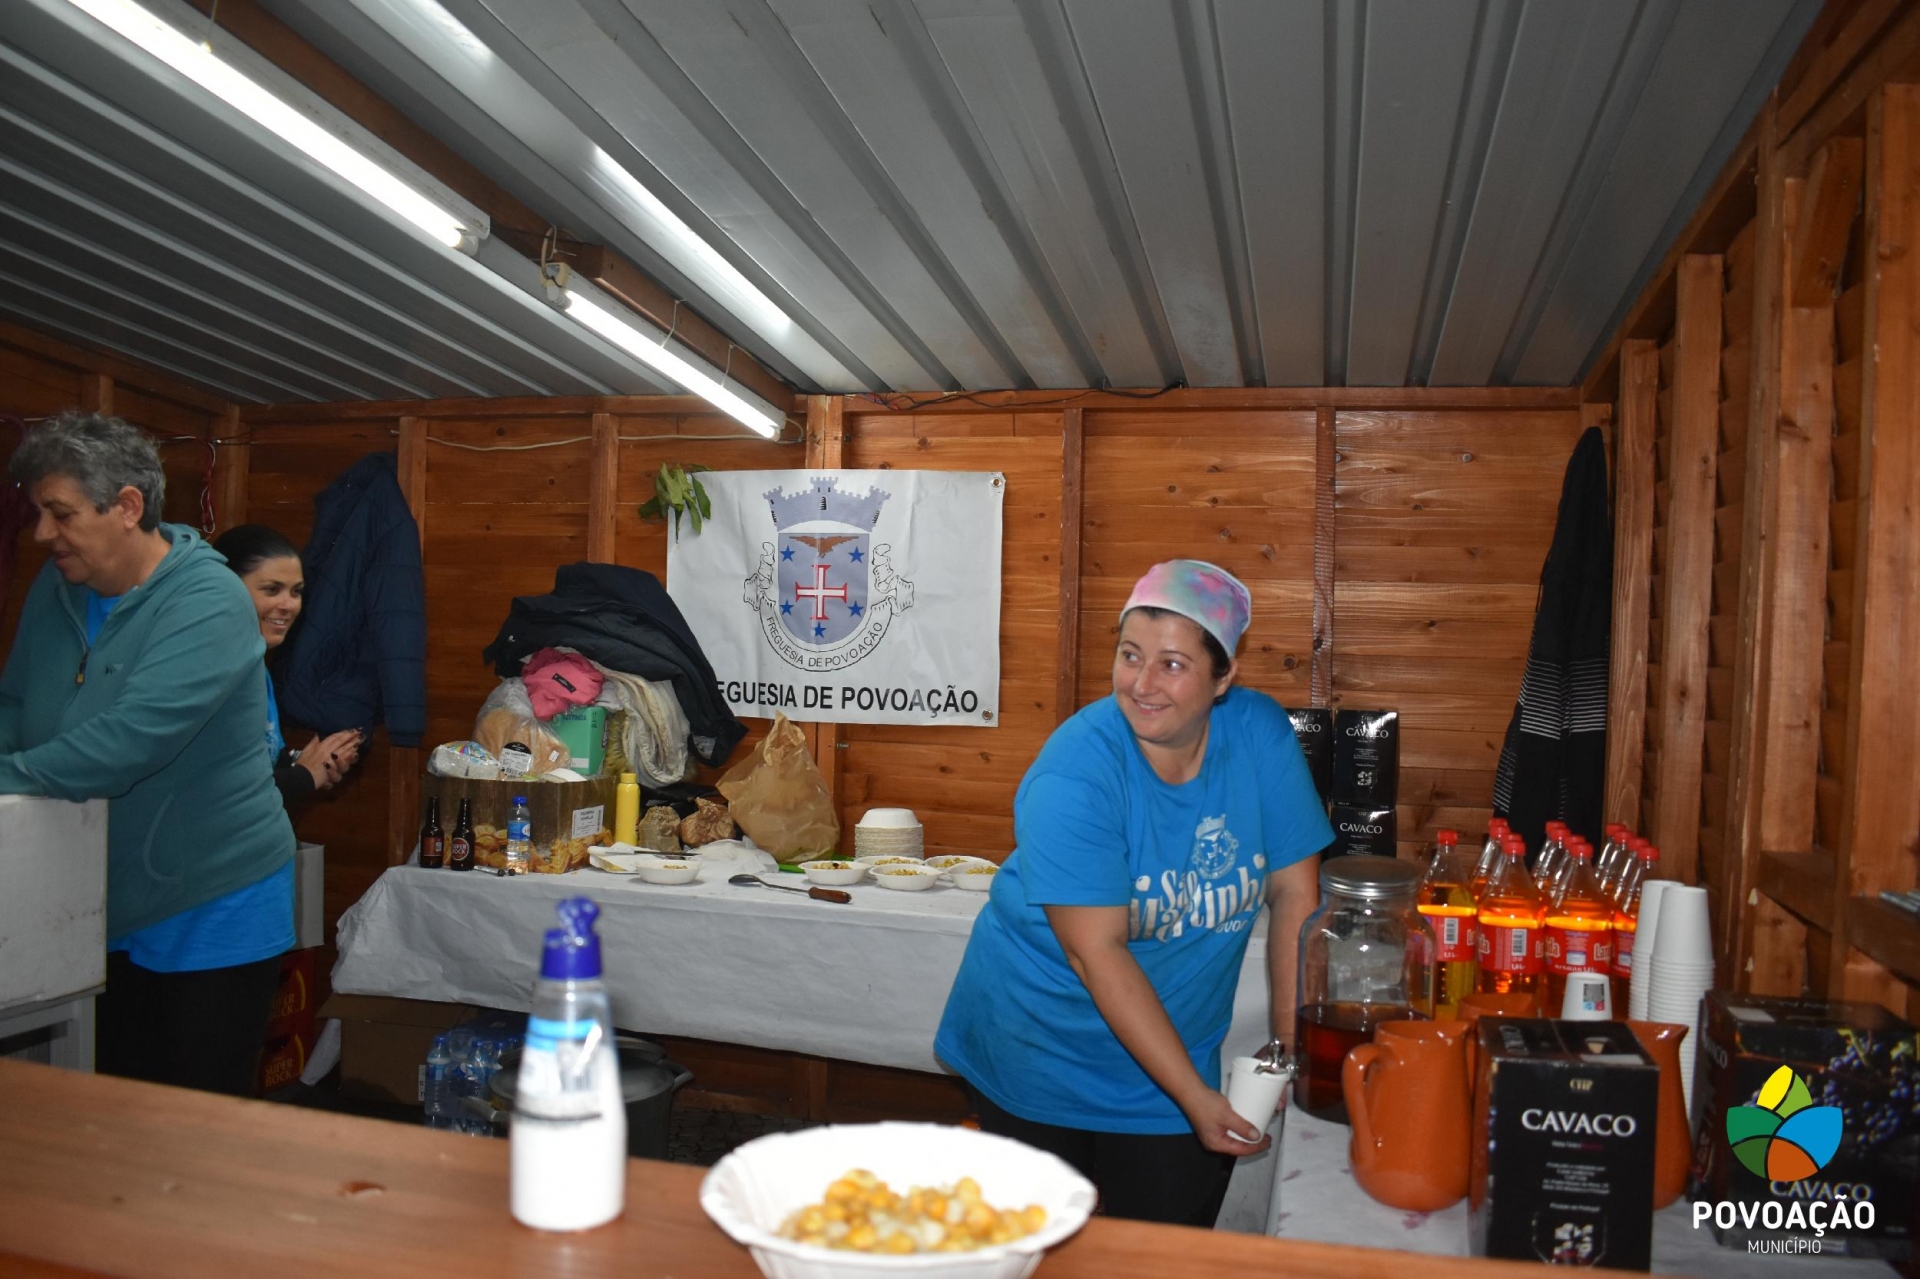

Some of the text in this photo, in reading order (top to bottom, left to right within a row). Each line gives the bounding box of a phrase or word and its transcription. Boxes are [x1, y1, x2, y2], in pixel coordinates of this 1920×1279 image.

[766, 616, 883, 667] FREGUESIA DE POVOAÇÃO
[717, 681, 978, 718] EGUESIA DE POVOAÇÃO
[1340, 822, 1383, 834] CAVACO
[264, 1058, 293, 1077] SUPER
[265, 1069, 293, 1088] BOCK
[1521, 1108, 1637, 1137] CAVACO
[1770, 1180, 1873, 1202] CAVACO
